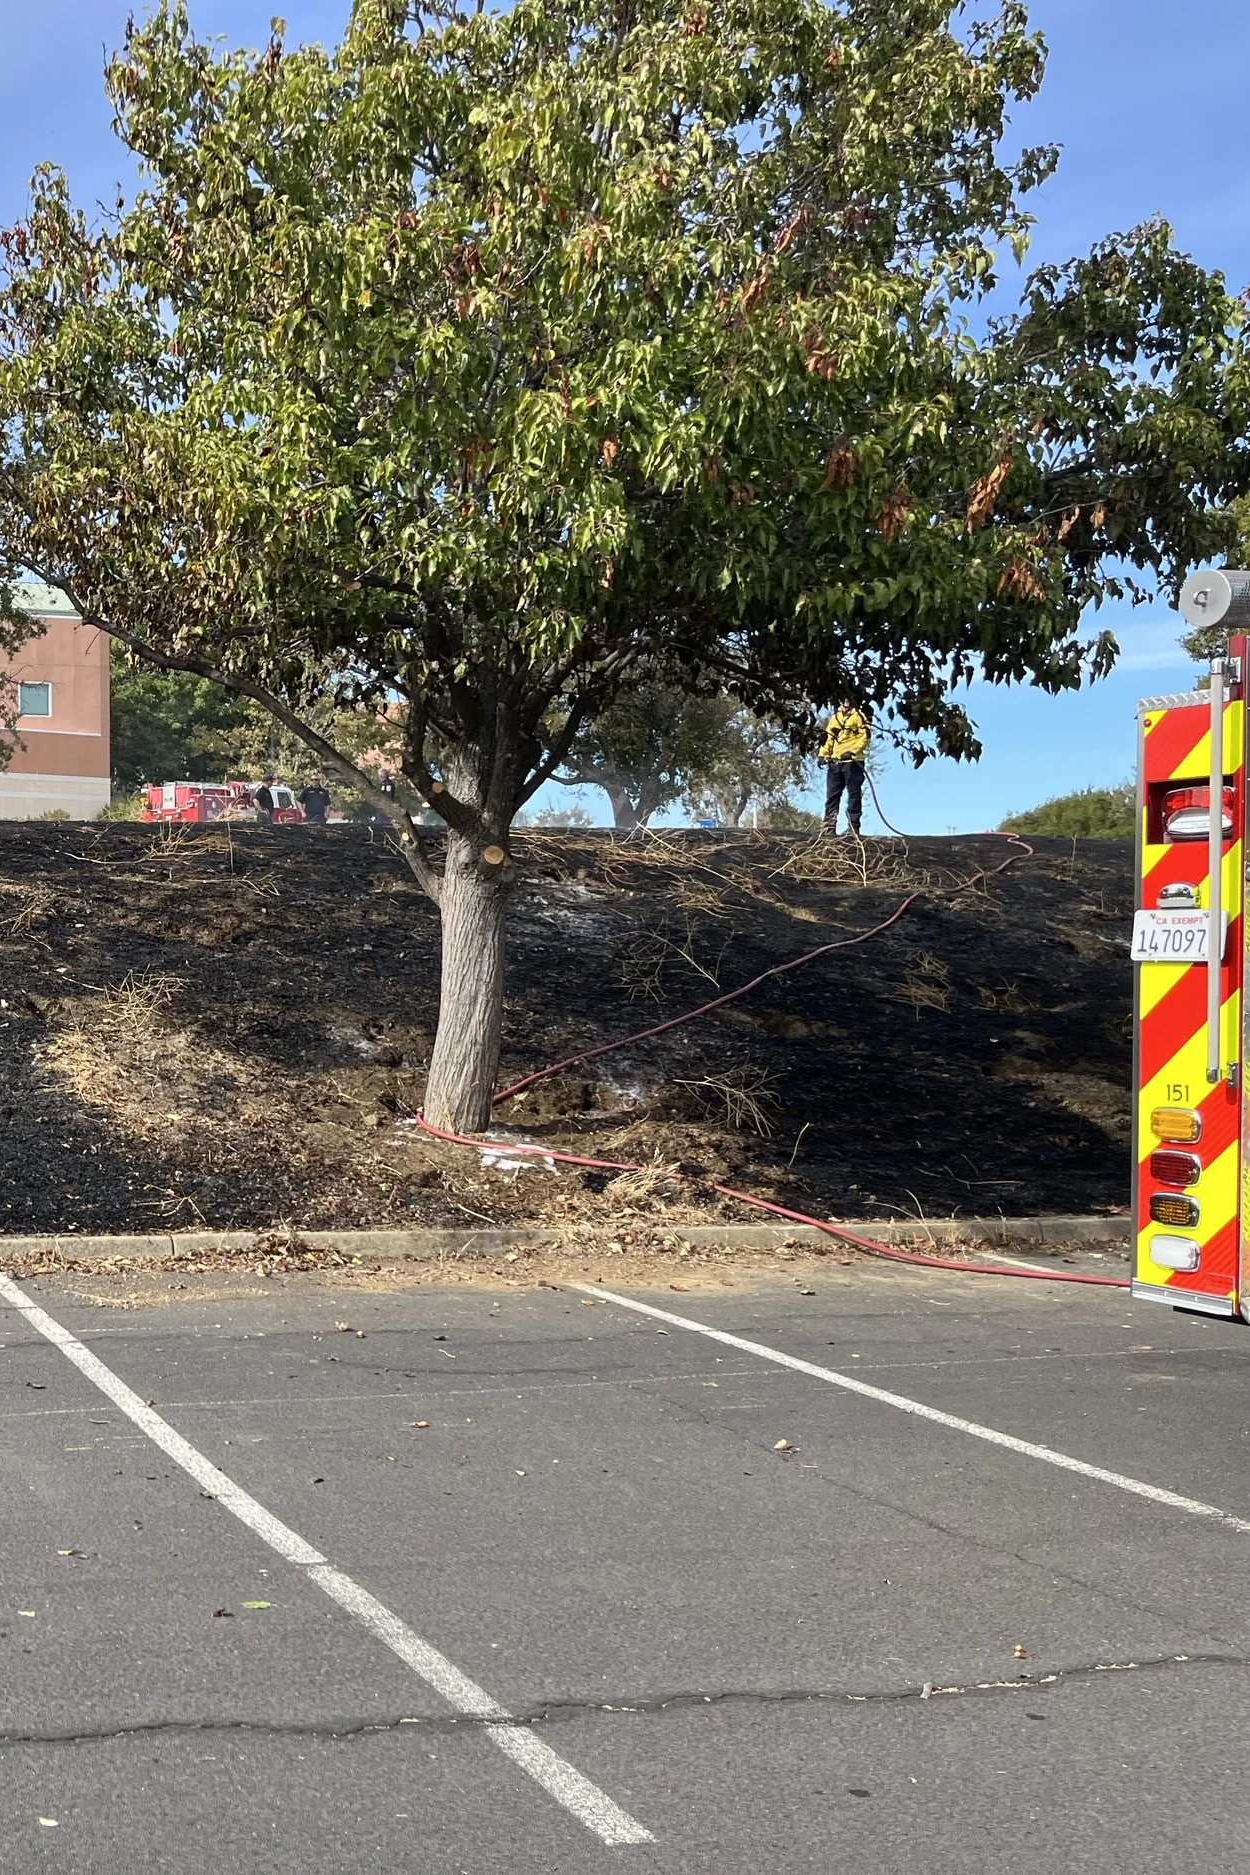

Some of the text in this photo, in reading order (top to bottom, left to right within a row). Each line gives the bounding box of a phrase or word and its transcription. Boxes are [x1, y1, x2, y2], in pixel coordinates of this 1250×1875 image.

[1156, 916, 1204, 925] CA EXEMPT
[1137, 929, 1208, 953] 147097
[1166, 1083, 1189, 1102] 151
